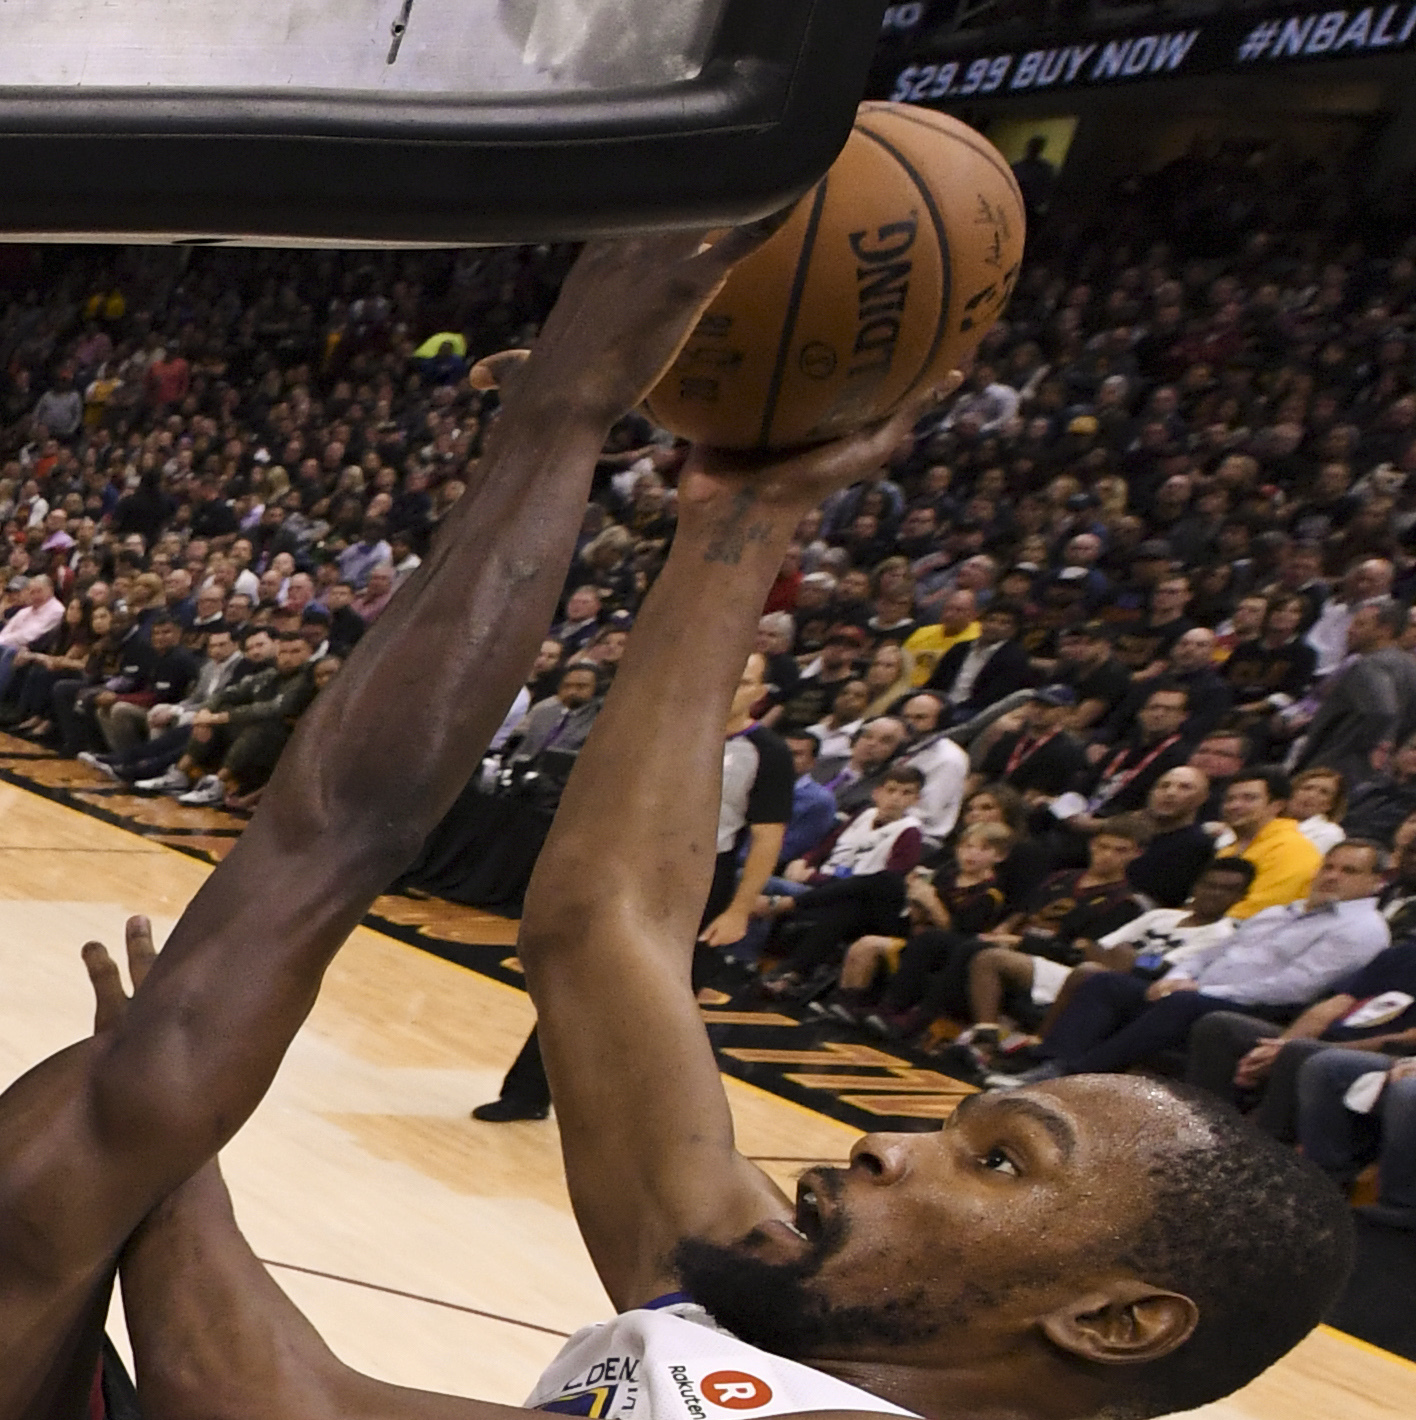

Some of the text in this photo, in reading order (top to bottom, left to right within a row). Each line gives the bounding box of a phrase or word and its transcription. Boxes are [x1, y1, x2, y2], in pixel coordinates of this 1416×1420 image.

[891, 54, 1012, 103] $29.99
[1010, 43, 1097, 91] BUY
[1092, 30, 1201, 80] NOW
[562, 1356, 640, 1392] LDEN
[667, 1365, 707, 1420] Rakuten
